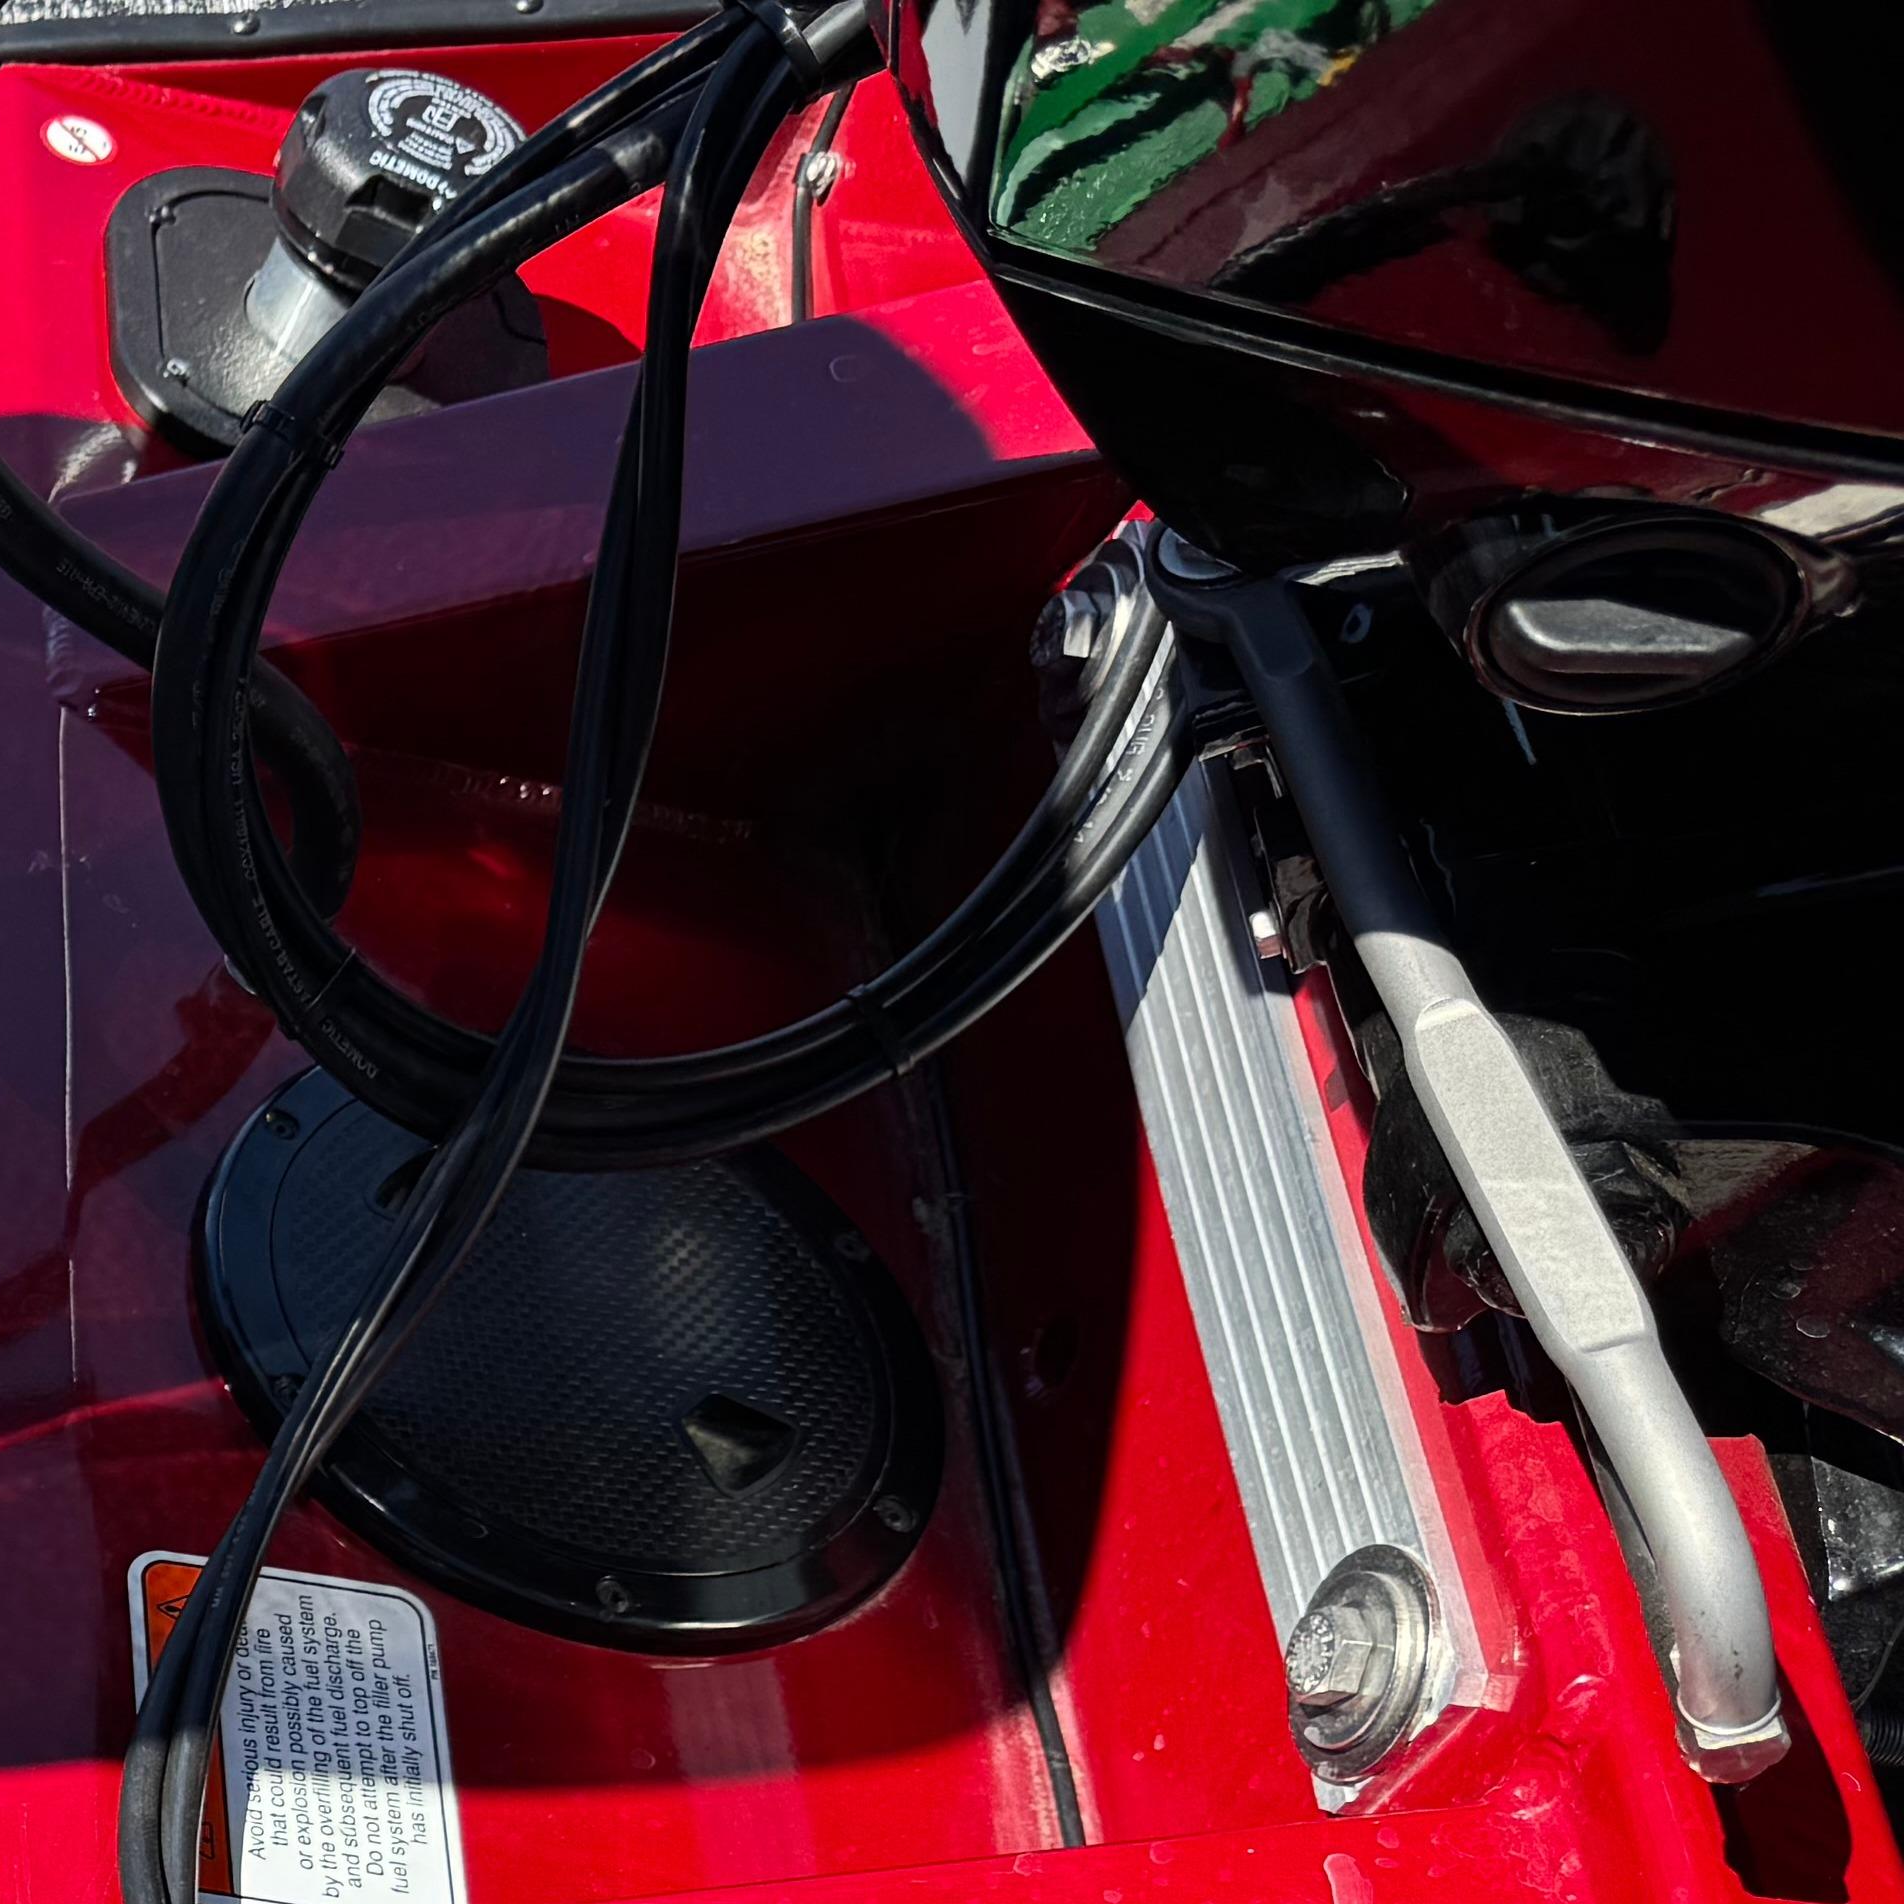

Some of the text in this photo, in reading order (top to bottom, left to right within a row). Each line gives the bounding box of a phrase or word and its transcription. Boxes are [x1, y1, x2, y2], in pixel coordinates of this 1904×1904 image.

[232, 1661, 269, 1860] Avoid serious injury or
[251, 1626, 289, 1846] that could result from fire
[274, 1612, 316, 1869] or explosion possibly caused
[296, 1593, 344, 1897] by the overfilling of the fuel system
[317, 1609, 363, 1887] and subsequent fuel discharge.
[343, 1627, 385, 1875] Do not attempt to top off the
[366, 1618, 410, 1894] fuel system after the filler pump
[393, 1671, 428, 1844] has initially shut off.
